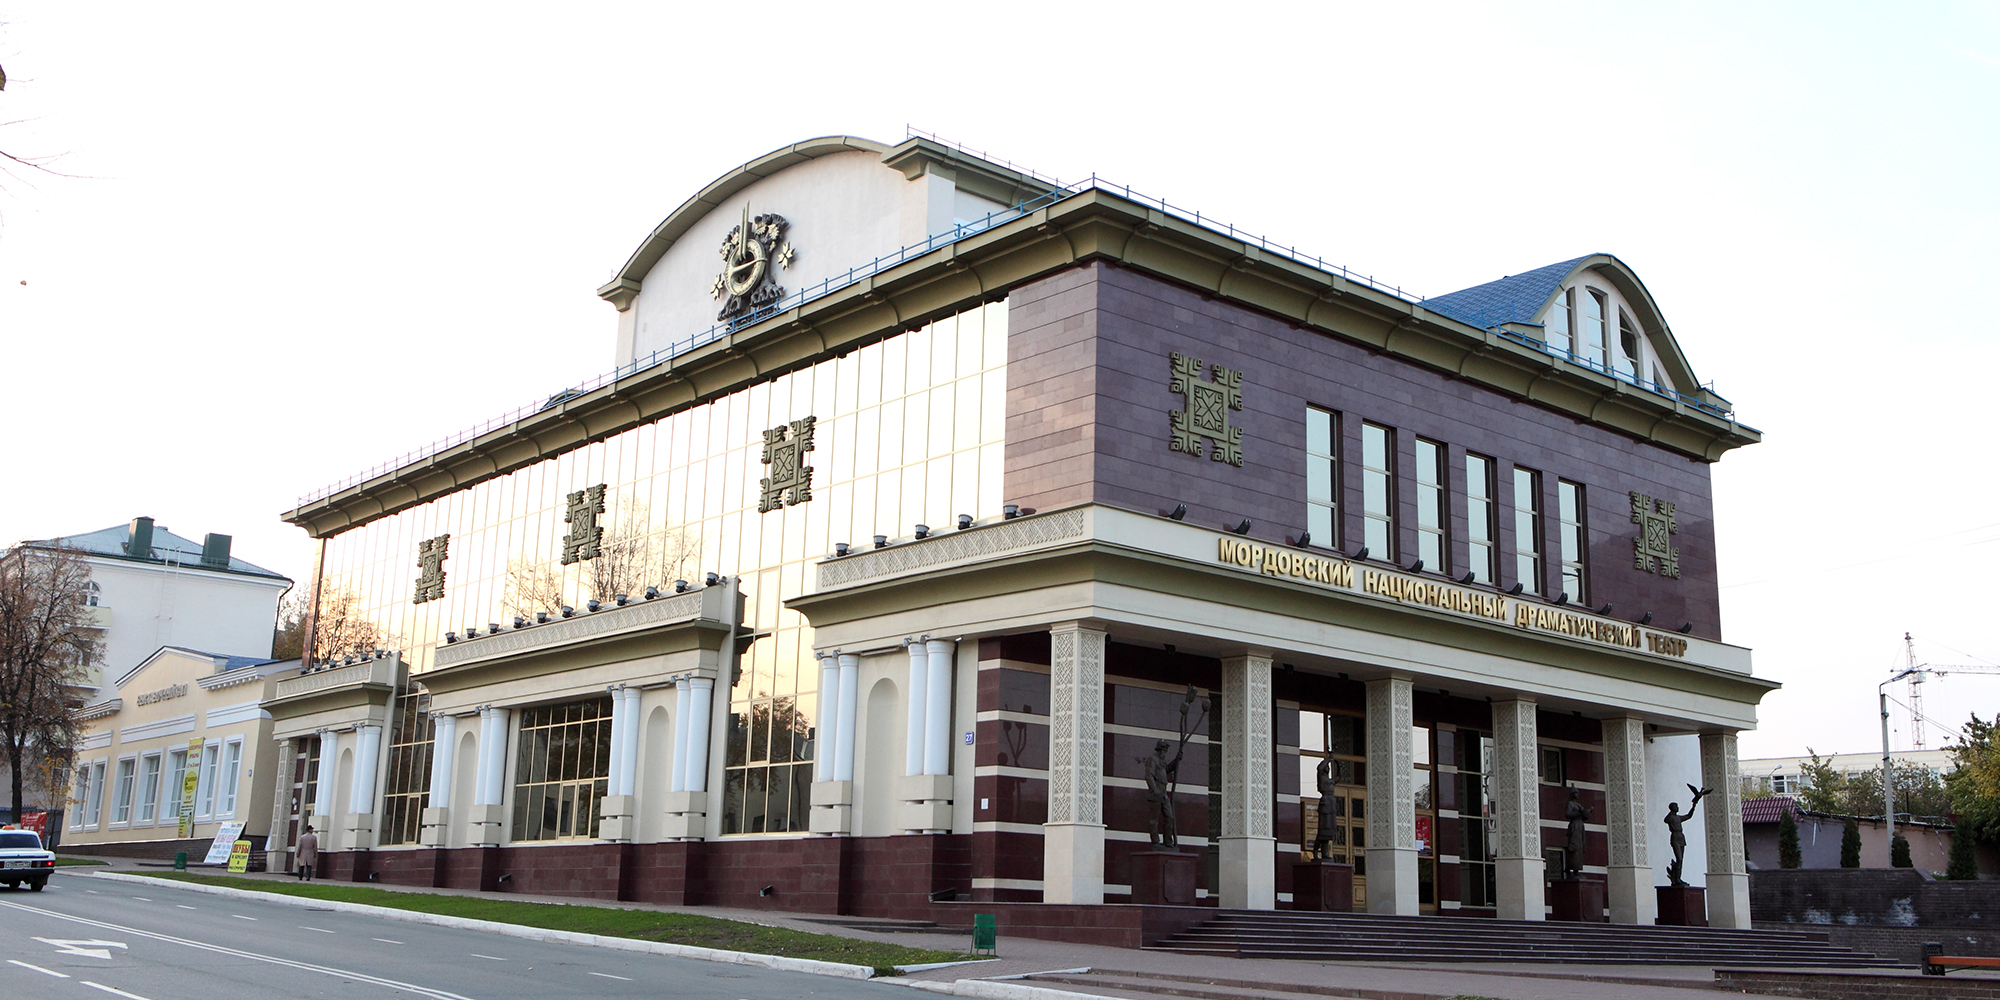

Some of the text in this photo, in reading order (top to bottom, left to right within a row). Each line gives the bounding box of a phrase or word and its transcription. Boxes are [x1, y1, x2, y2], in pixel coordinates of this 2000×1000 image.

[1218, 537, 1688, 657] МОРДОВСКИЙ НАЦИОНАЛЬНЫЙ ДРАМАТИЧЕСКИЙ ТЕАТР
